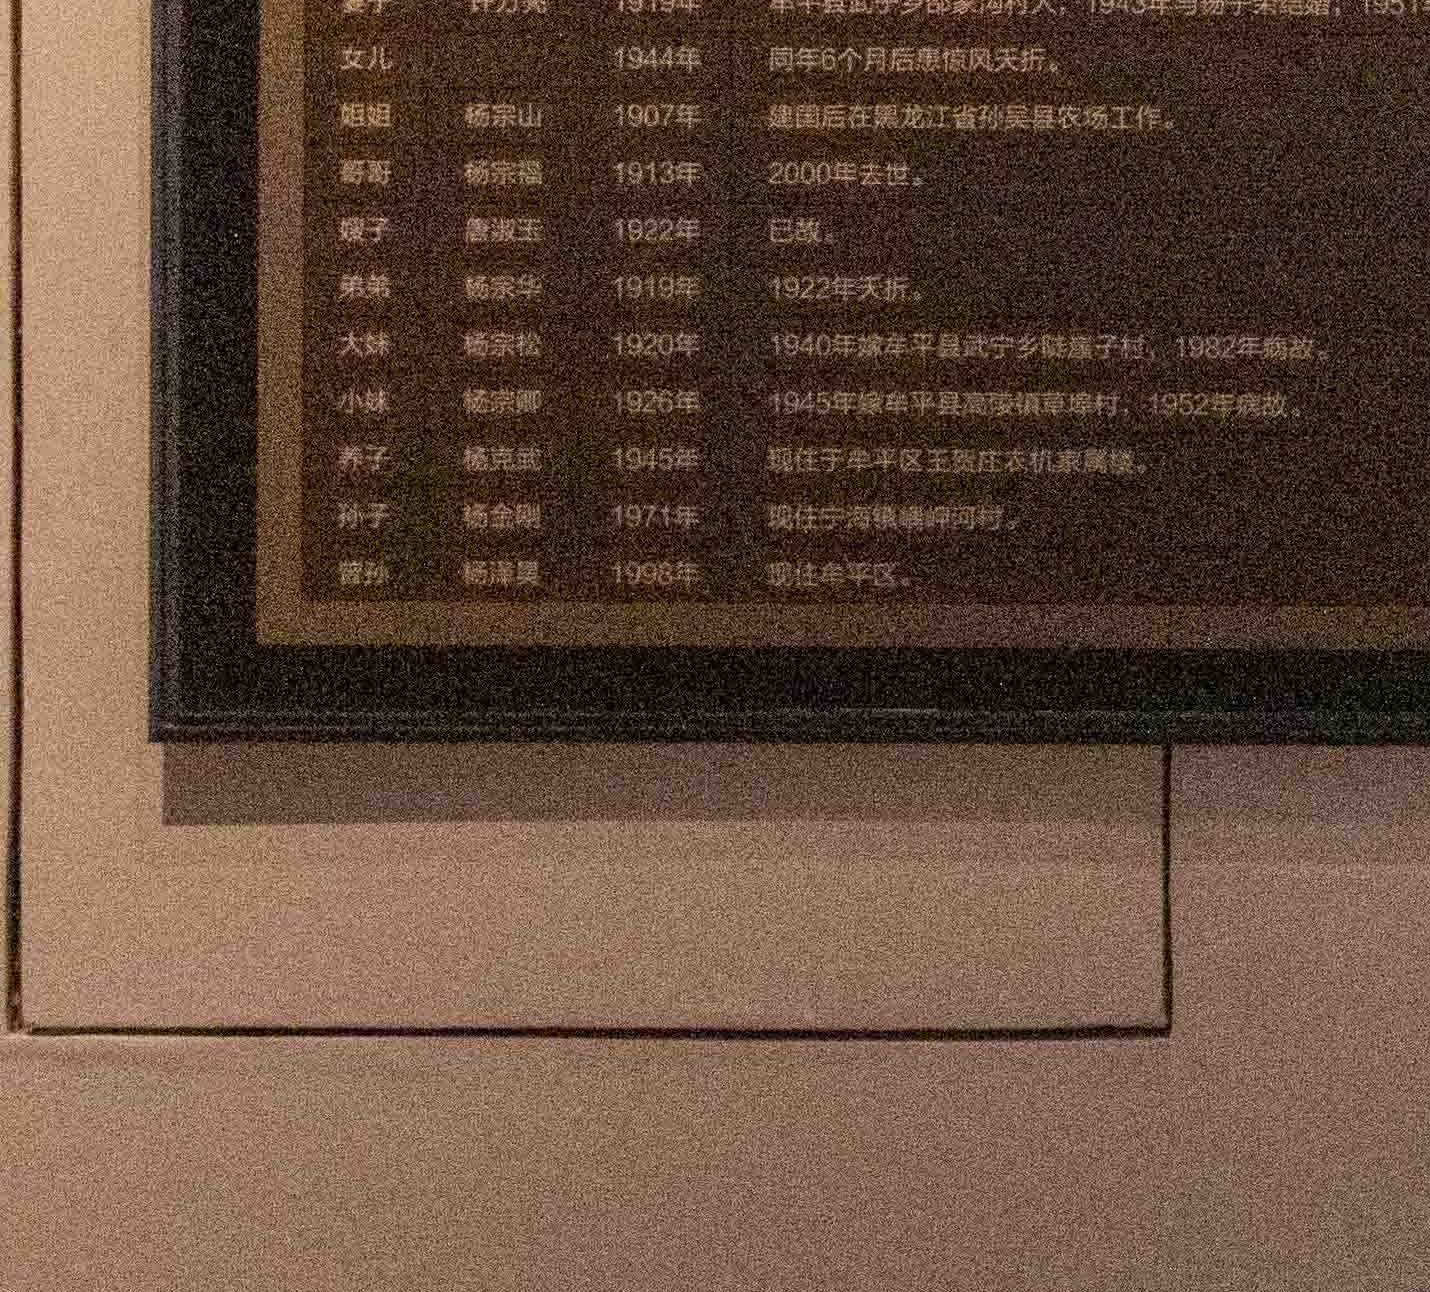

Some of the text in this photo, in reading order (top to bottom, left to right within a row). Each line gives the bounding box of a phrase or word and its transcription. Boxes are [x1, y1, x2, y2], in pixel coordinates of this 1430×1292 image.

[340, 46, 394, 72] 女儿
[614, 45, 701, 72] 1944年
[614, 103, 701, 129] 1907年
[613, 160, 701, 186] 1913年
[614, 217, 701, 243] 1922年
[613, 275, 701, 300] 1919年
[612, 331, 701, 359] 1920年
[614, 389, 701, 414] 1926年
[613, 445, 701, 472] 1945年
[611, 504, 701, 529] 1971年
[612, 560, 701, 587] 1998年
